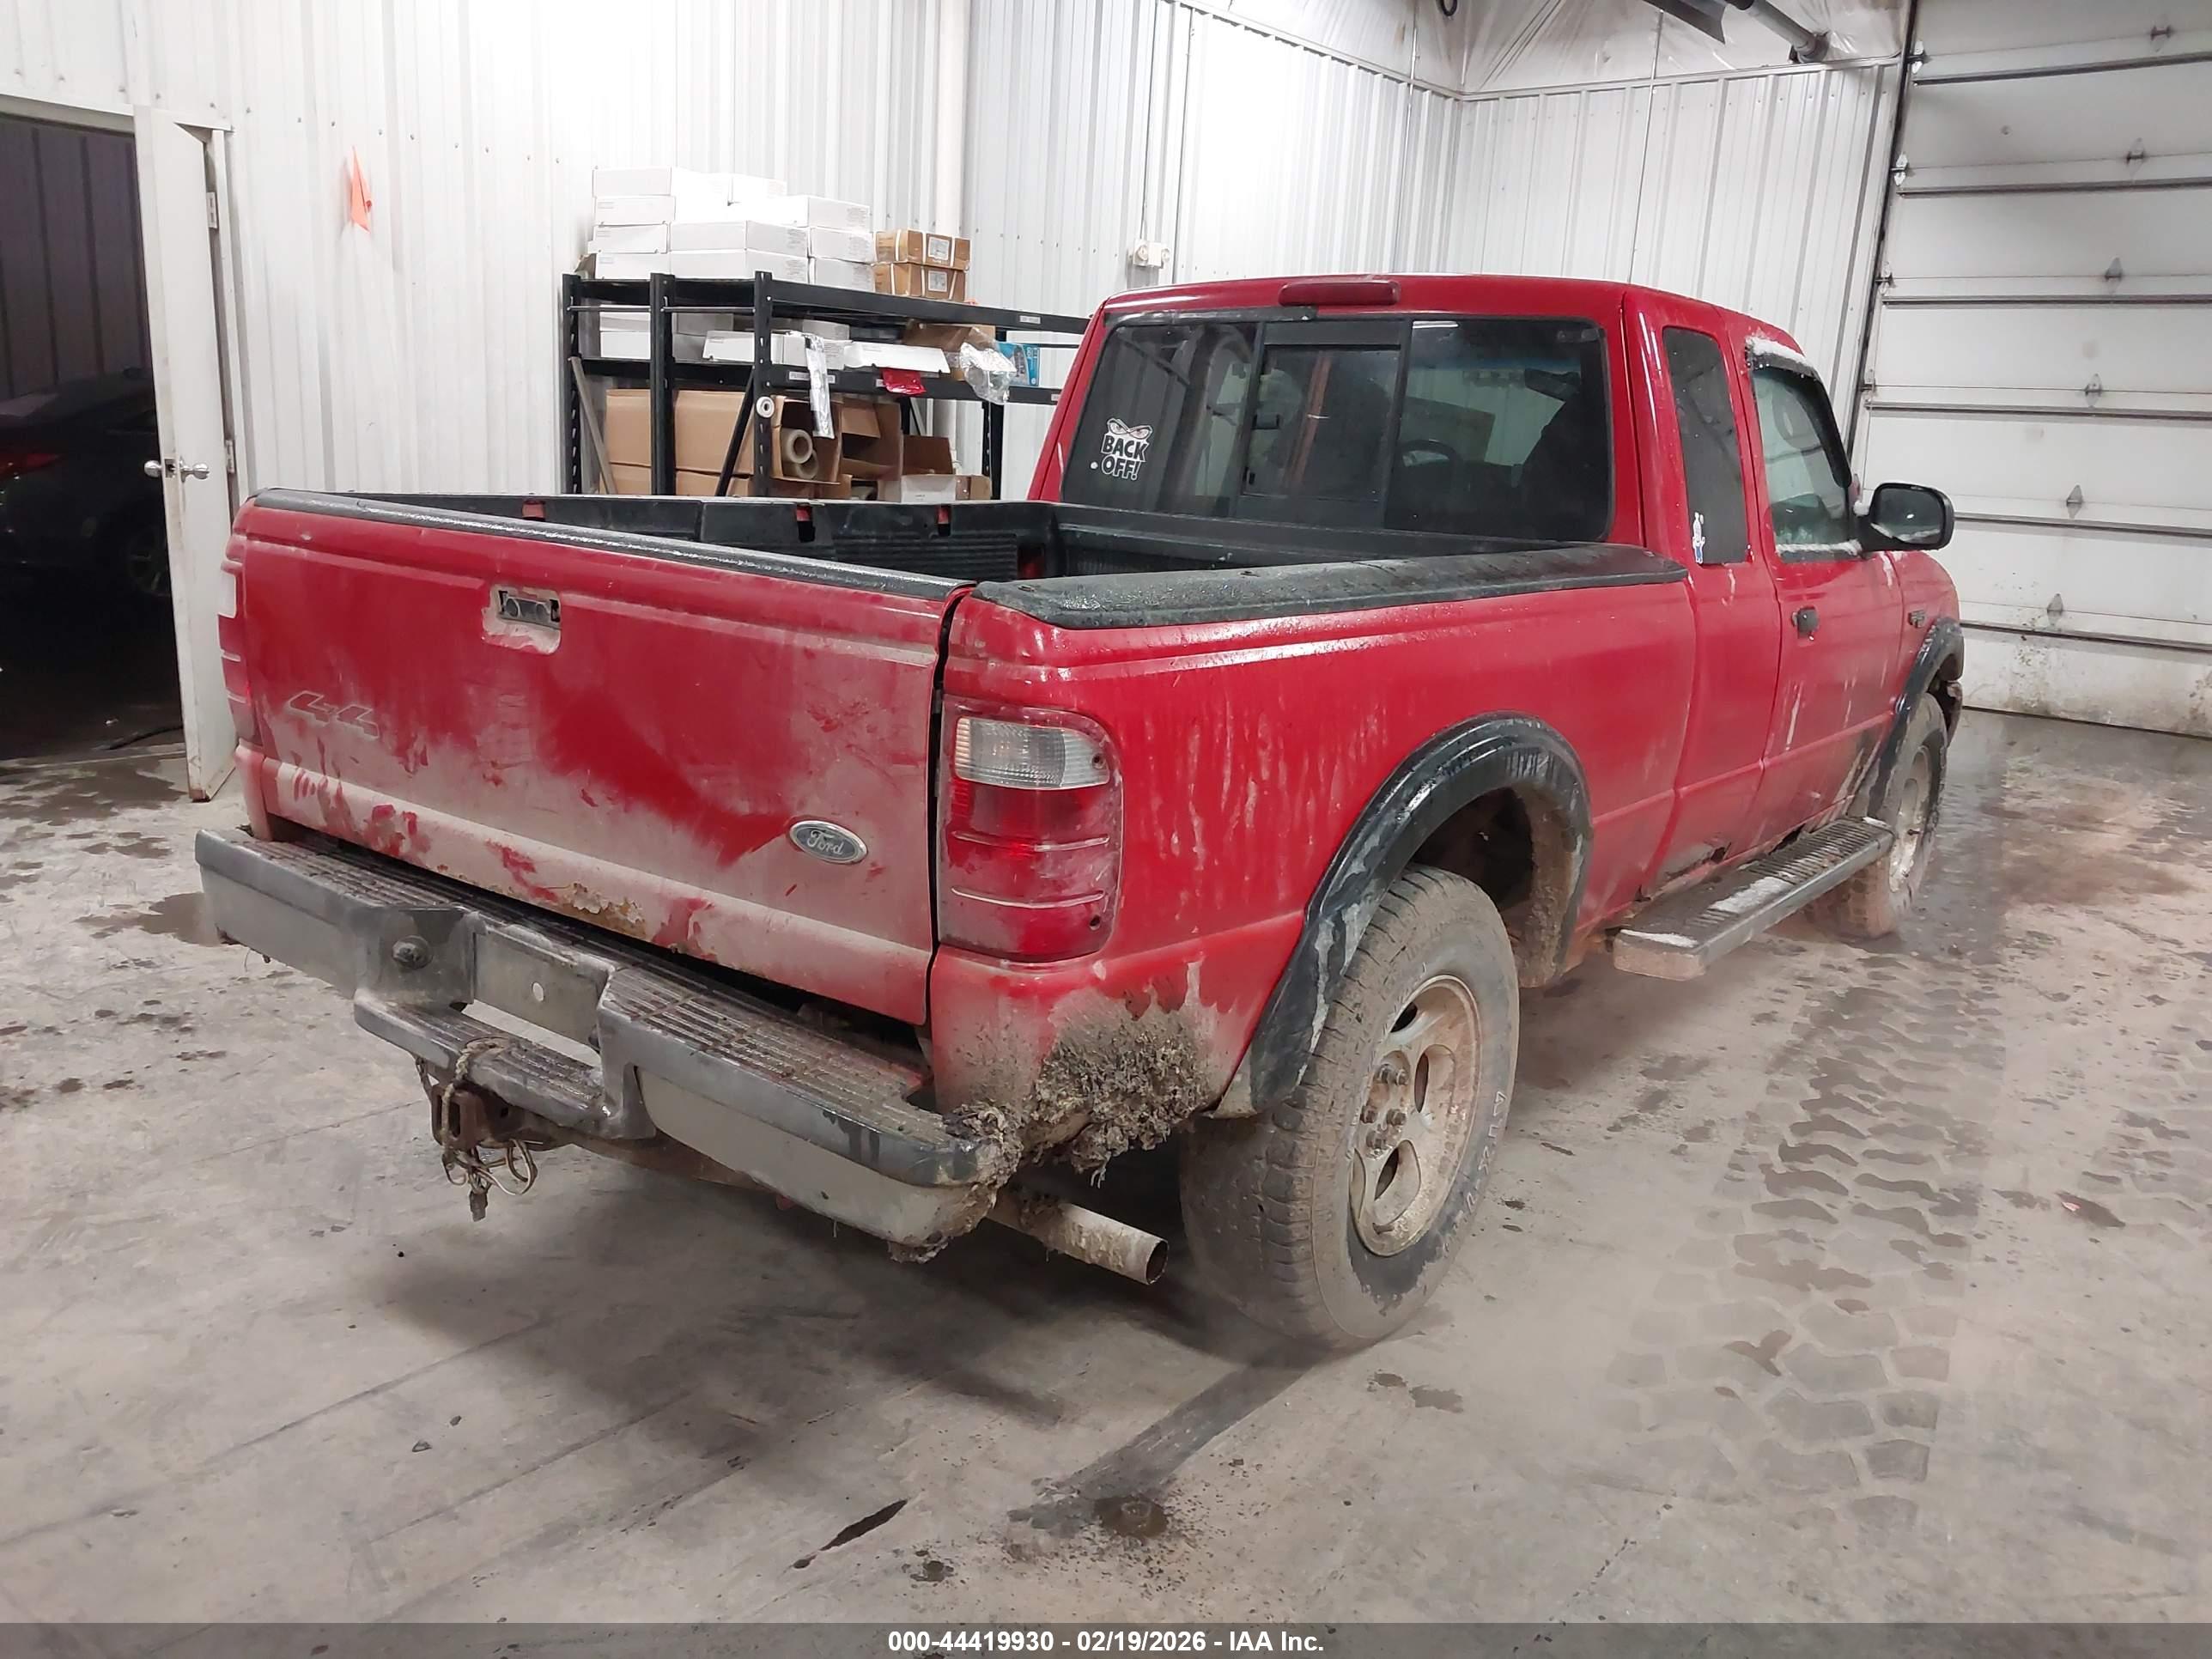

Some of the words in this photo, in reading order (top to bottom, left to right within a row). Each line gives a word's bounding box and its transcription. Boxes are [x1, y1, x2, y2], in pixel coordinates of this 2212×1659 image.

[1102, 434, 1148, 461] BACK
[1102, 454, 1140, 480] OFF!
[806, 829, 844, 855] Ford
